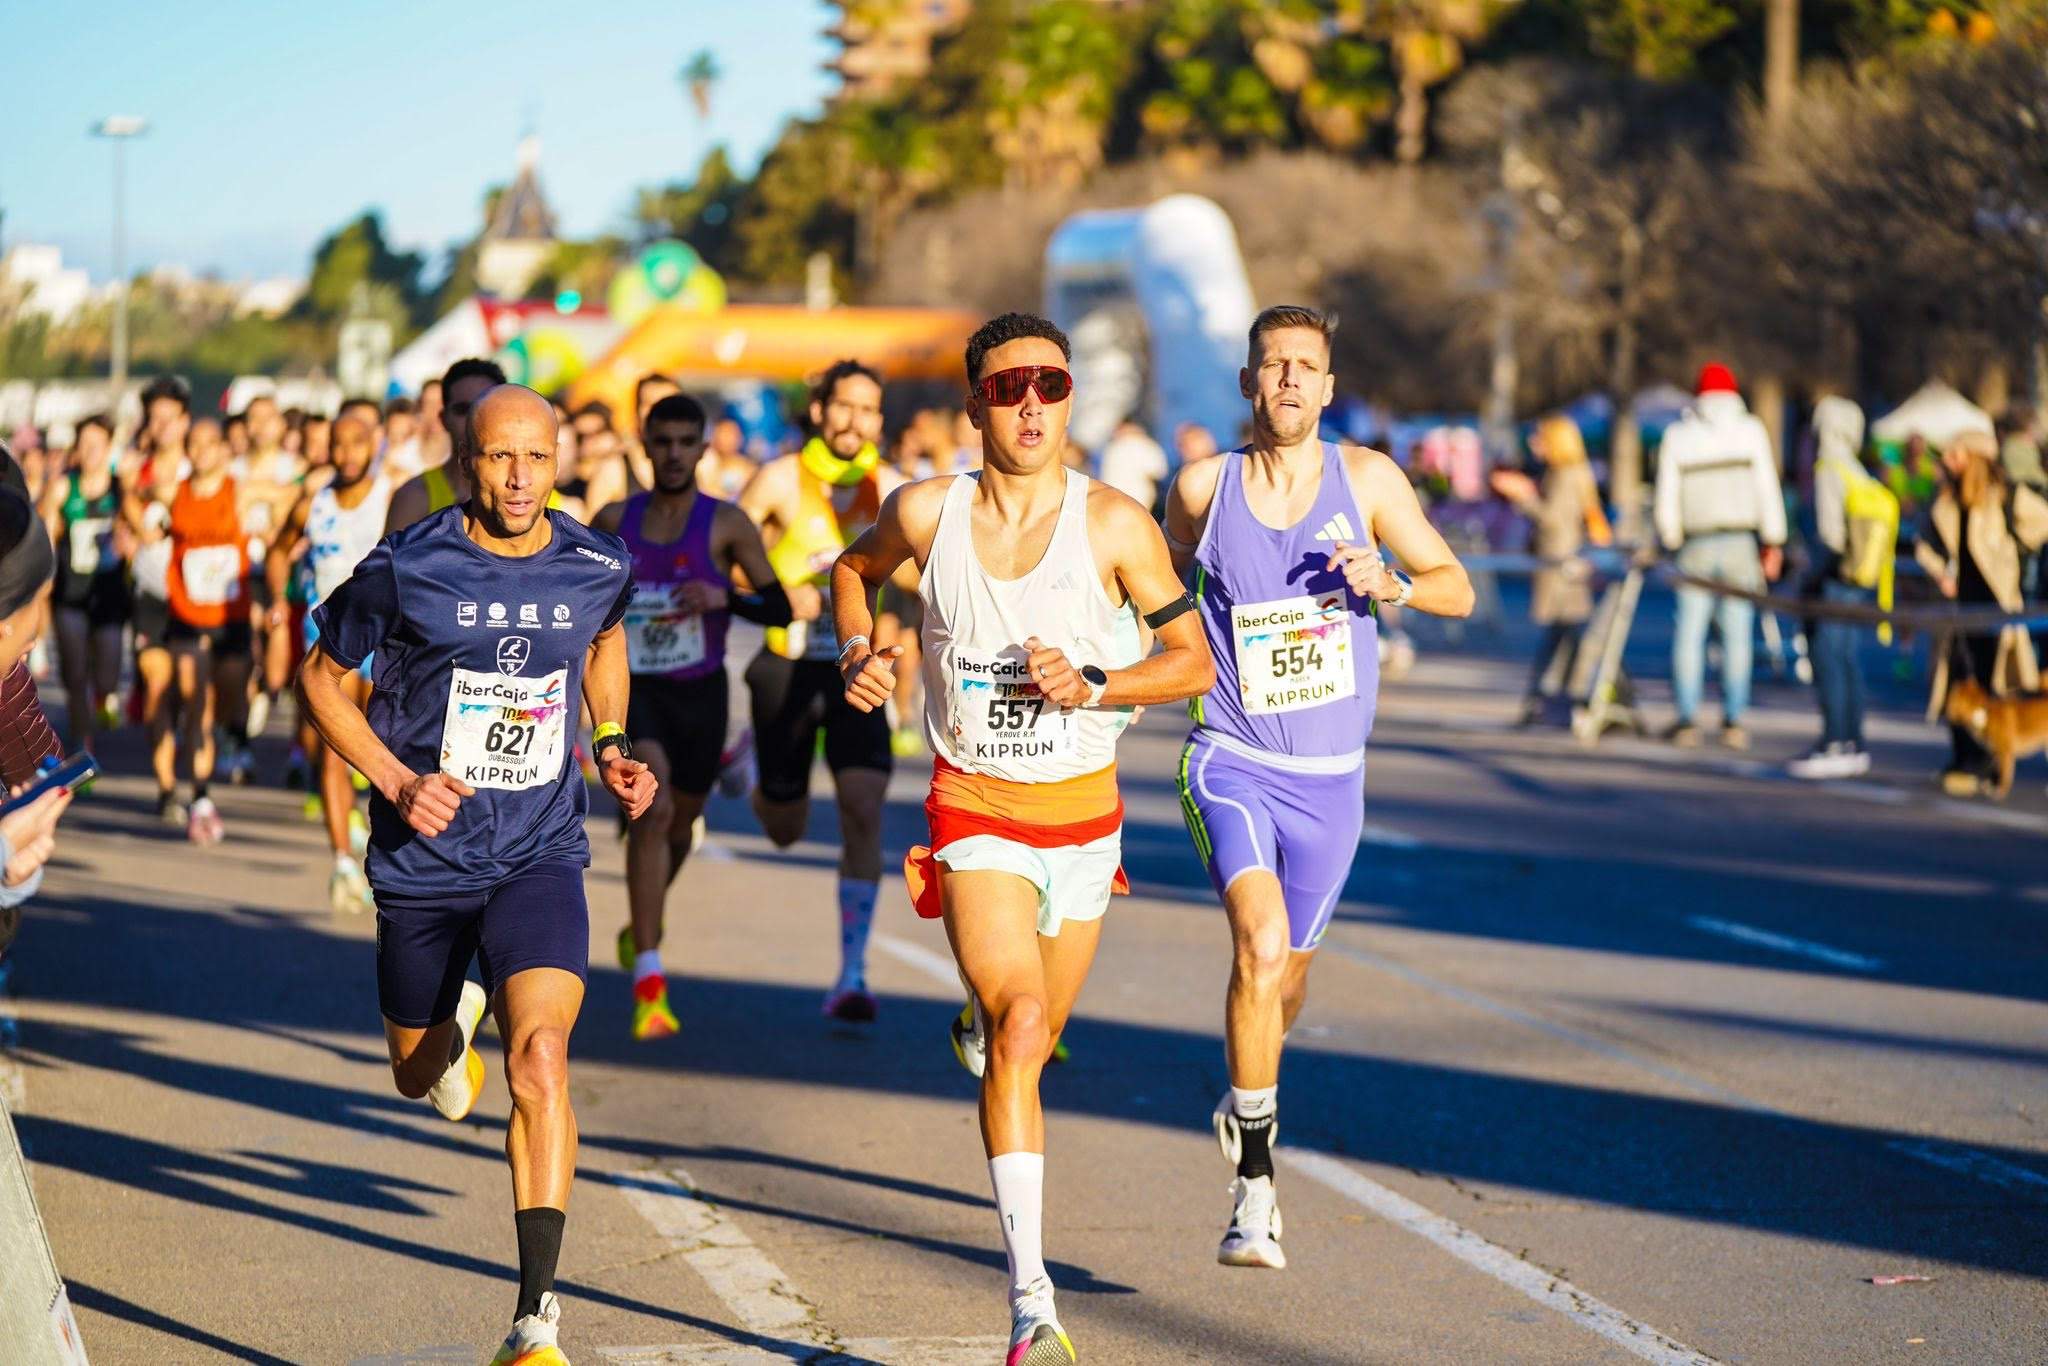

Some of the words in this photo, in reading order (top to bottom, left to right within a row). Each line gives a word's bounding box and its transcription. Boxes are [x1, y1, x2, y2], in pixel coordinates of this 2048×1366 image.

[576, 547, 613, 565] CRAFT
[1237, 610, 1304, 628] iberCaja
[1271, 644, 1323, 678] 554
[456, 680, 528, 703] iberCaja
[1266, 681, 1336, 707] KIPRUN
[987, 700, 1044, 730] 557
[485, 722, 536, 756] 621
[976, 740, 1053, 758] KIPRUN
[465, 765, 538, 784] KIPRUN
